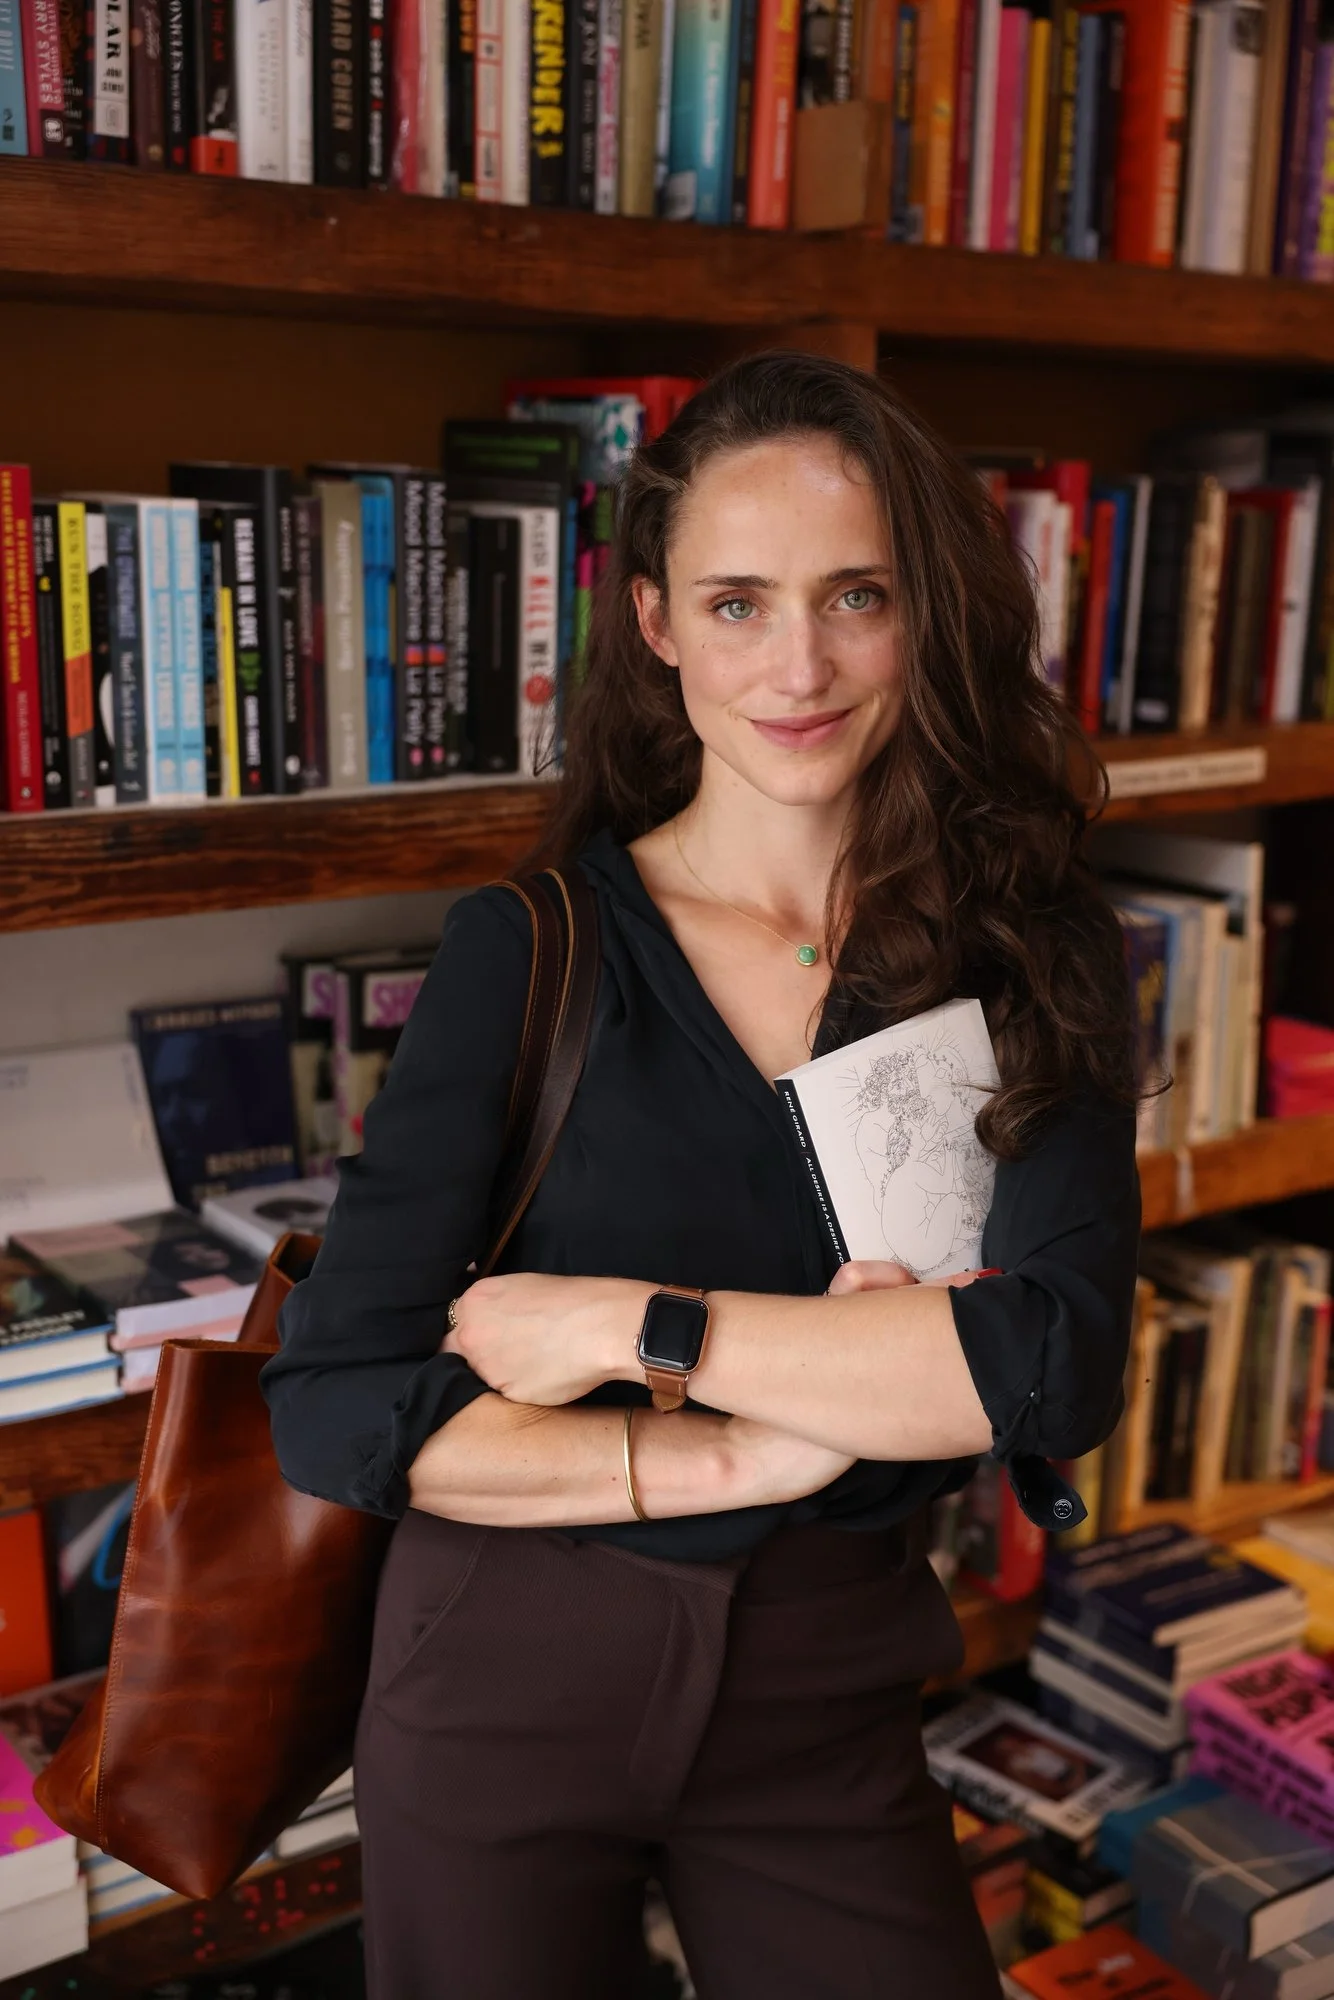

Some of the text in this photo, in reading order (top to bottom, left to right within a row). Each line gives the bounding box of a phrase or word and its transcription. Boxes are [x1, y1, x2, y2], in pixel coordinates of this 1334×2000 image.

[106, 0, 121, 59] LAR
[36, 40, 53, 104] STYLES
[331, 58, 354, 131] COHEN
[67, 517, 81, 556] RUN
[405, 481, 425, 641] Mood Machine
[427, 482, 447, 641] Mood Machine
[69, 561, 82, 597] THE
[234, 517, 259, 649] REMAIN IN LOVE
[526, 575, 553, 633] KILL
[792, 1114, 807, 1148] GIRARD
[805, 1156, 815, 1172] ALL
[811, 1173, 825, 1202] DESIRE
[821, 1203, 828, 1212] IS
[827, 1221, 840, 1250] DESIRE
[836, 1251, 845, 1266] FO
